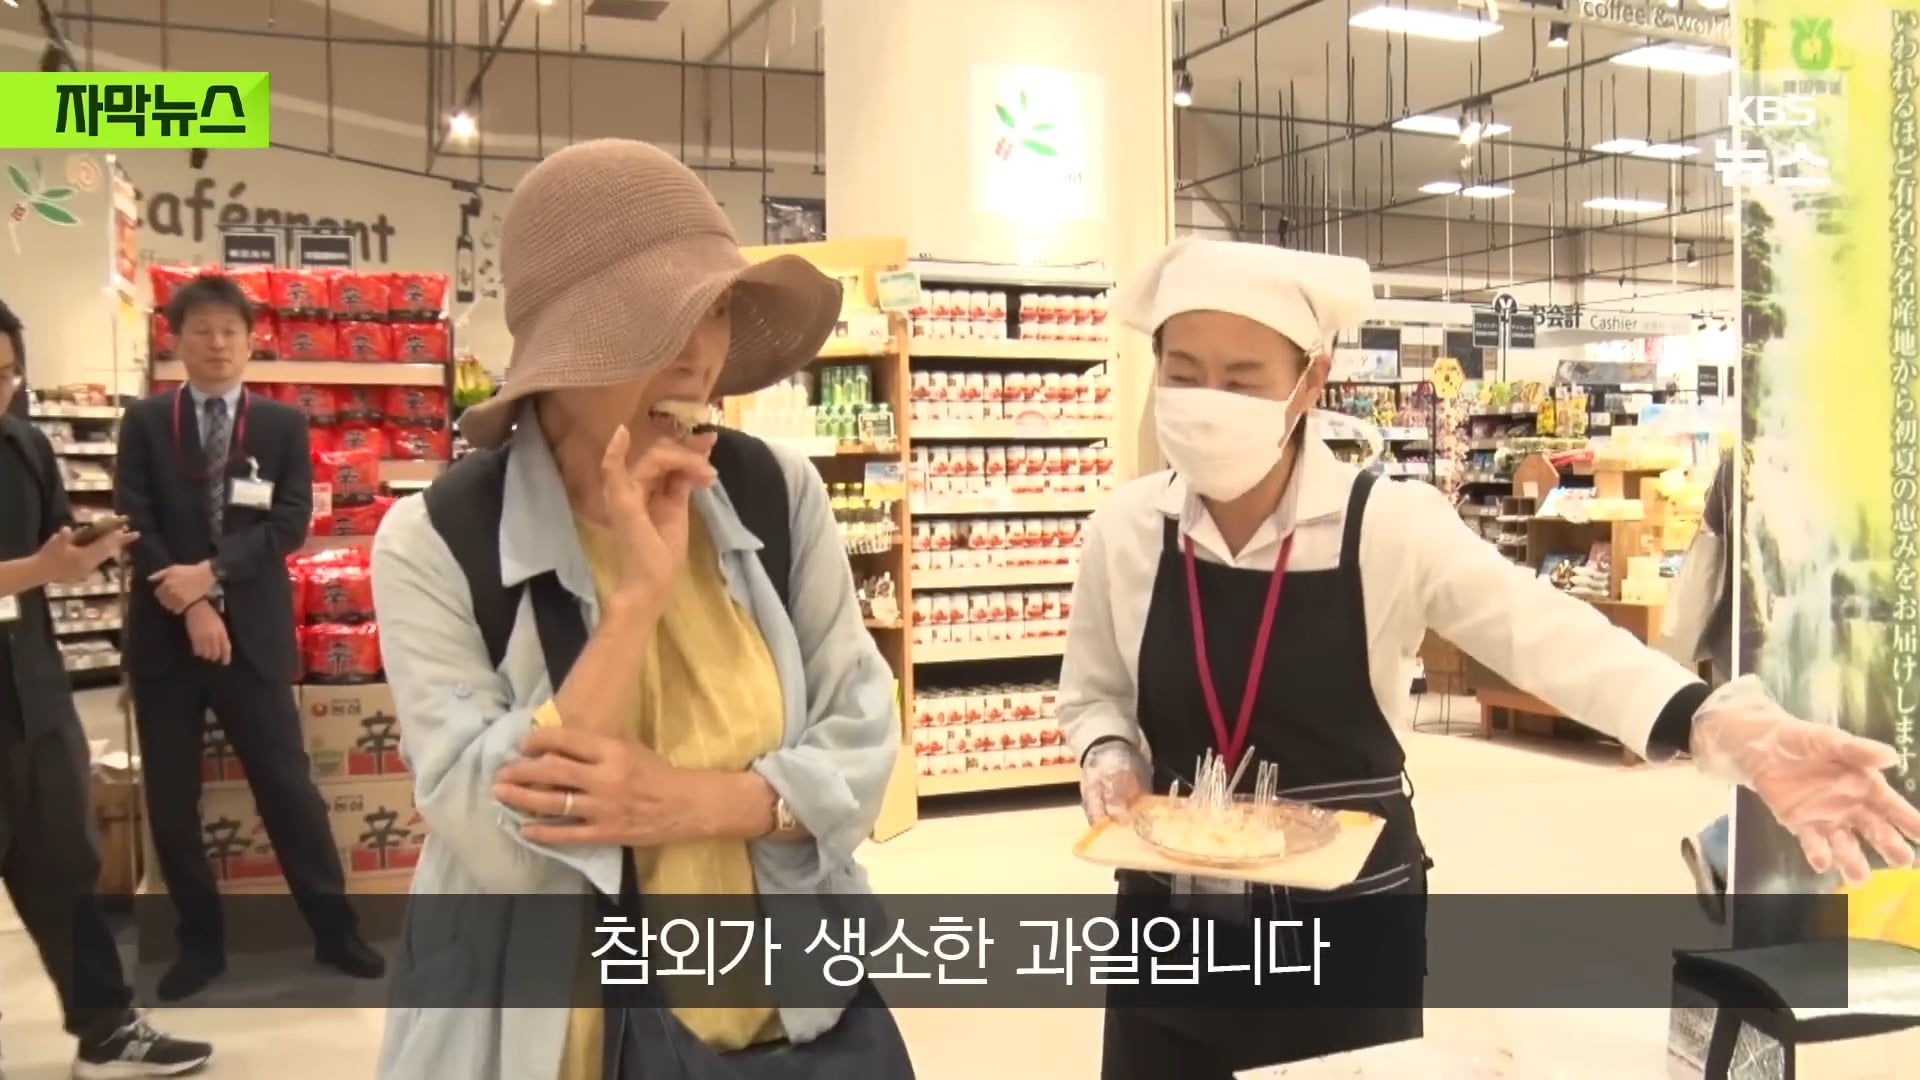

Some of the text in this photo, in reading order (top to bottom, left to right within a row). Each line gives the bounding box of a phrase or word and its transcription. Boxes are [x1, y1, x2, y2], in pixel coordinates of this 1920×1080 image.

[1583, 0, 1647, 27] coffee
[1654, 8, 1676, 28] &
[134, 177, 396, 265] afént
[1590, 315, 1638, 331] Cashier
[356, 710, 400, 775] 辛
[201, 816, 253, 881] 辛
[359, 806, 410, 869] 辛
